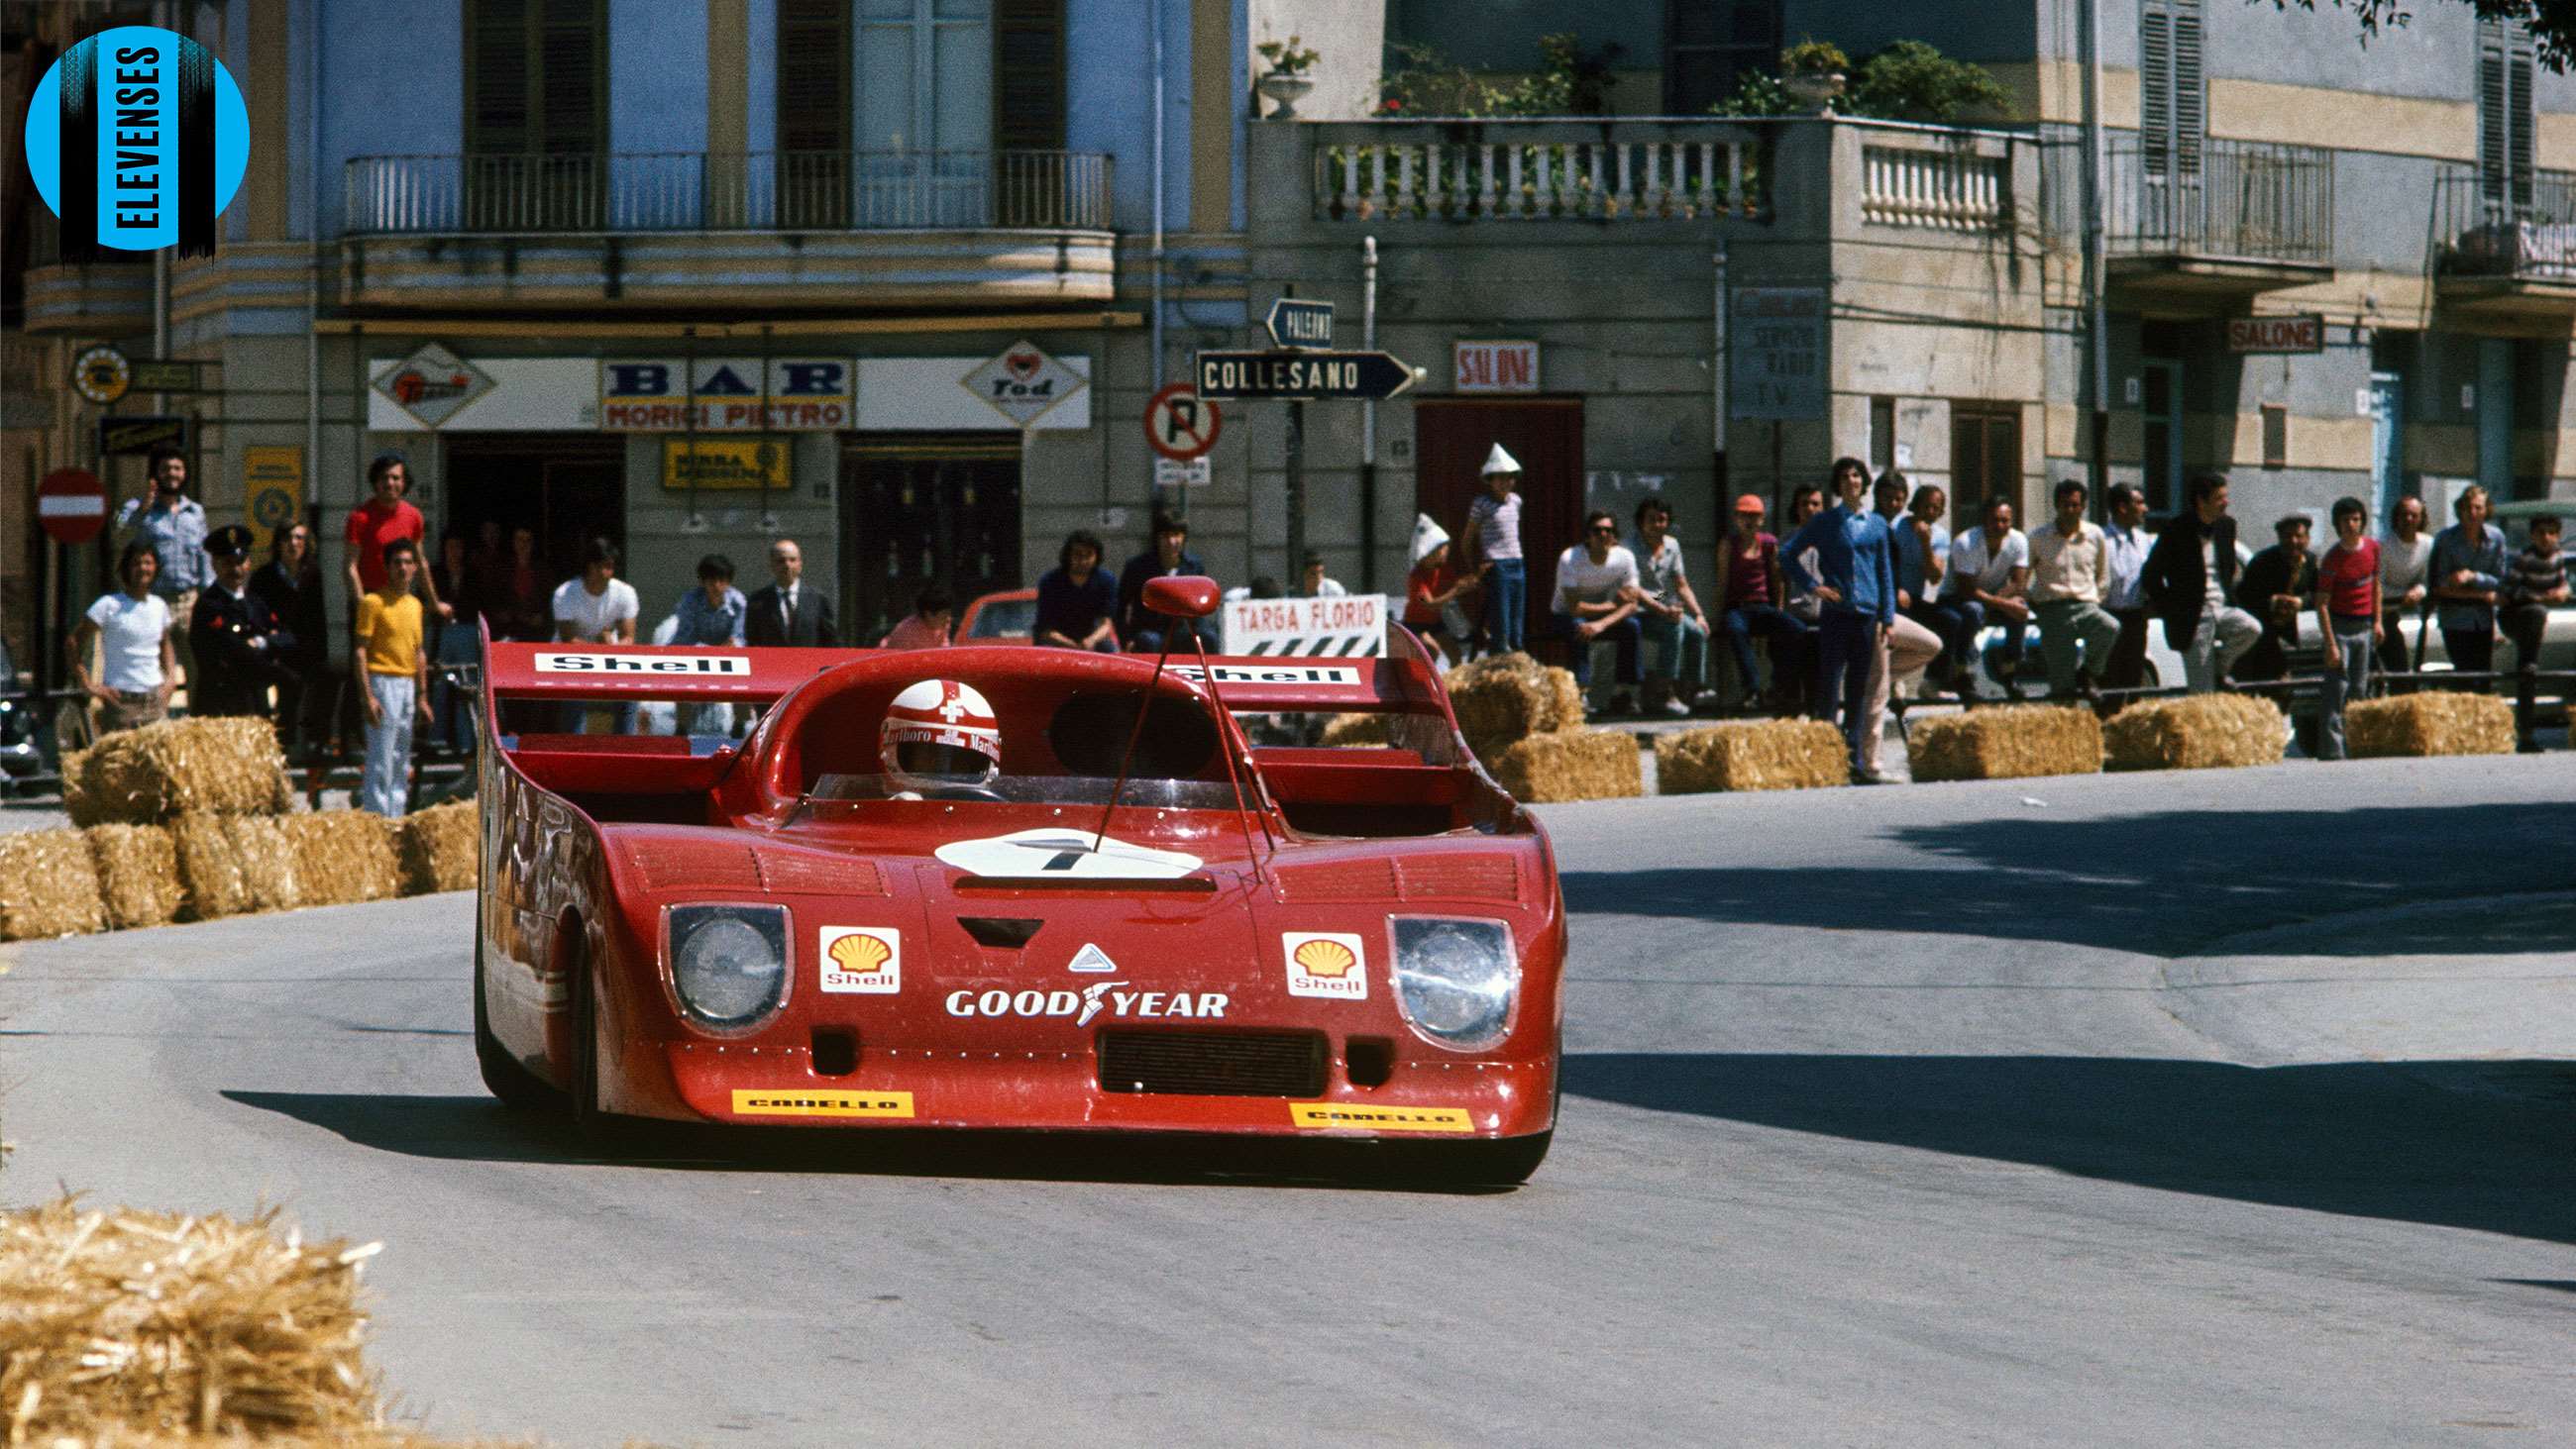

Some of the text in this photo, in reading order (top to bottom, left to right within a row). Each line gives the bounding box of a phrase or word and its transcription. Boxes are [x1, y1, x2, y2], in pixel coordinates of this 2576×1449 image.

[2234, 321, 2314, 347] SALONE
[607, 363, 843, 396] BAR
[1205, 362, 1358, 389] COLLESANO
[606, 404, 708, 427] MORICI
[724, 403, 842, 426] PIETRO
[1236, 600, 1375, 633] TARGA FLORIO
[553, 657, 733, 673] Shell
[826, 974, 894, 985] Shell
[1294, 977, 1361, 993] Shell
